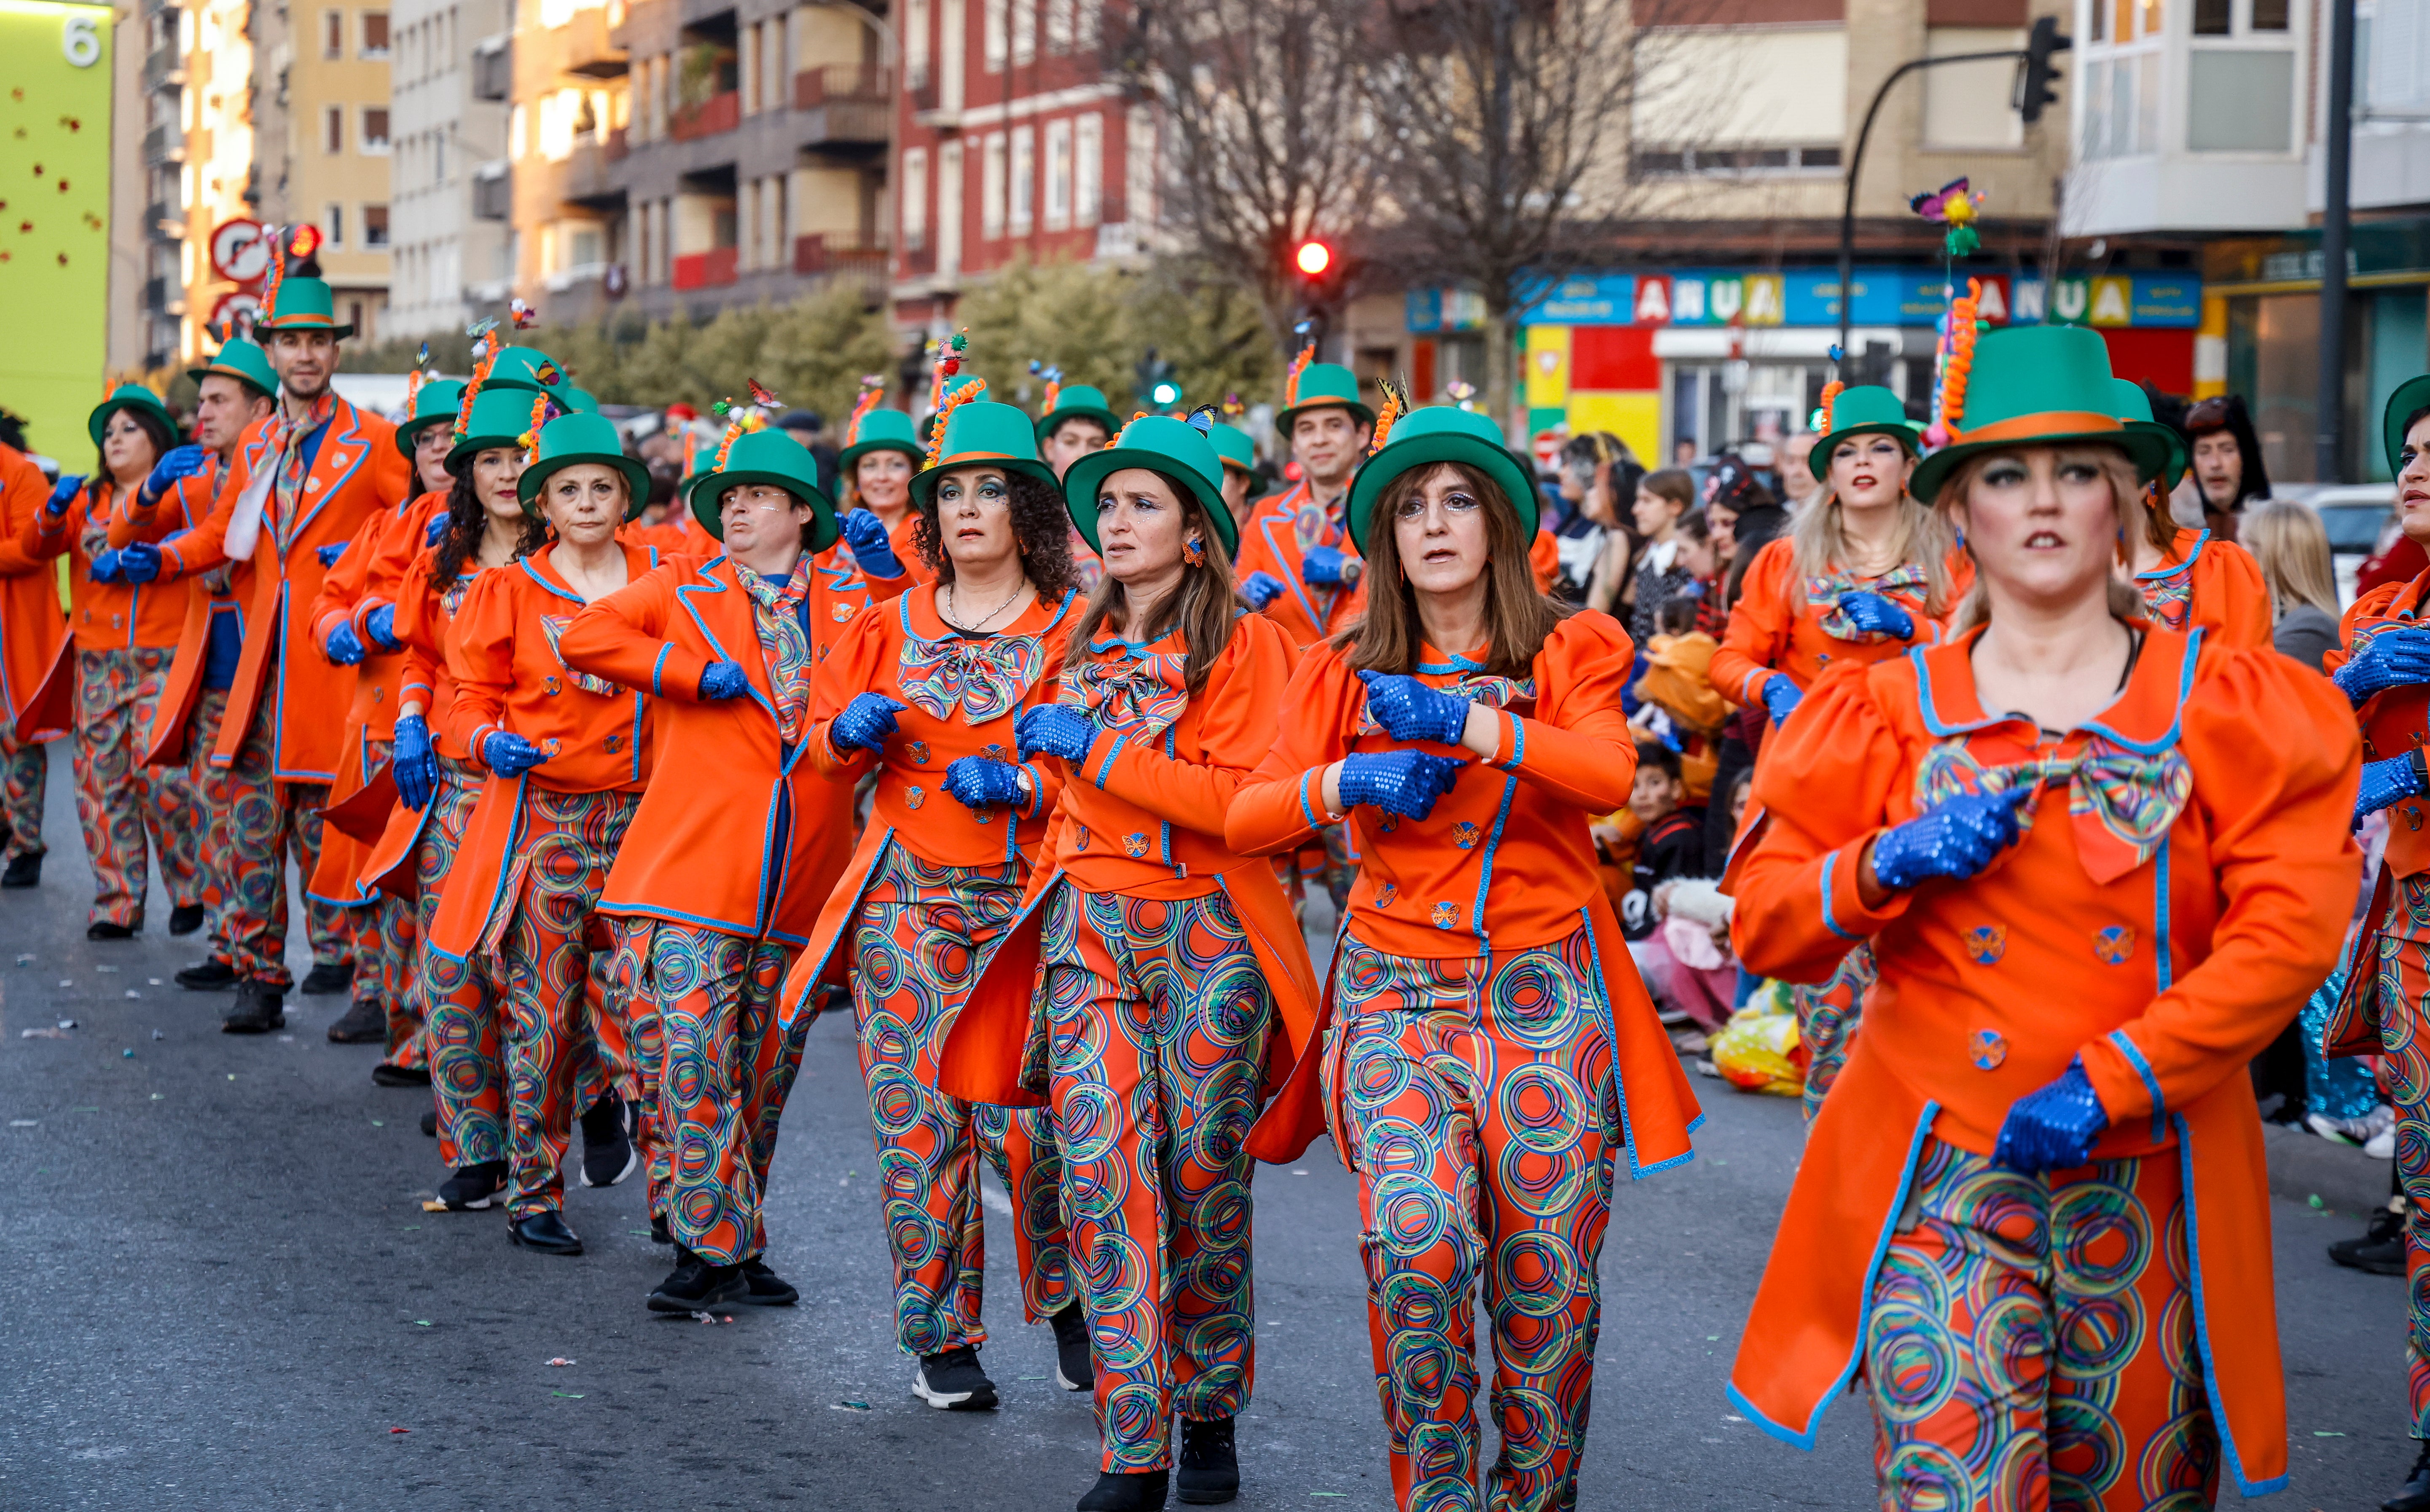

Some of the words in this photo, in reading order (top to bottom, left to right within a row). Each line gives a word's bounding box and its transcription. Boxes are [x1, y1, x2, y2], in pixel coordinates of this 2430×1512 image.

[65, 18, 100, 67] 6
[1637, 279, 1778, 320] ANUA
[1976, 280, 2127, 319] ANUA
